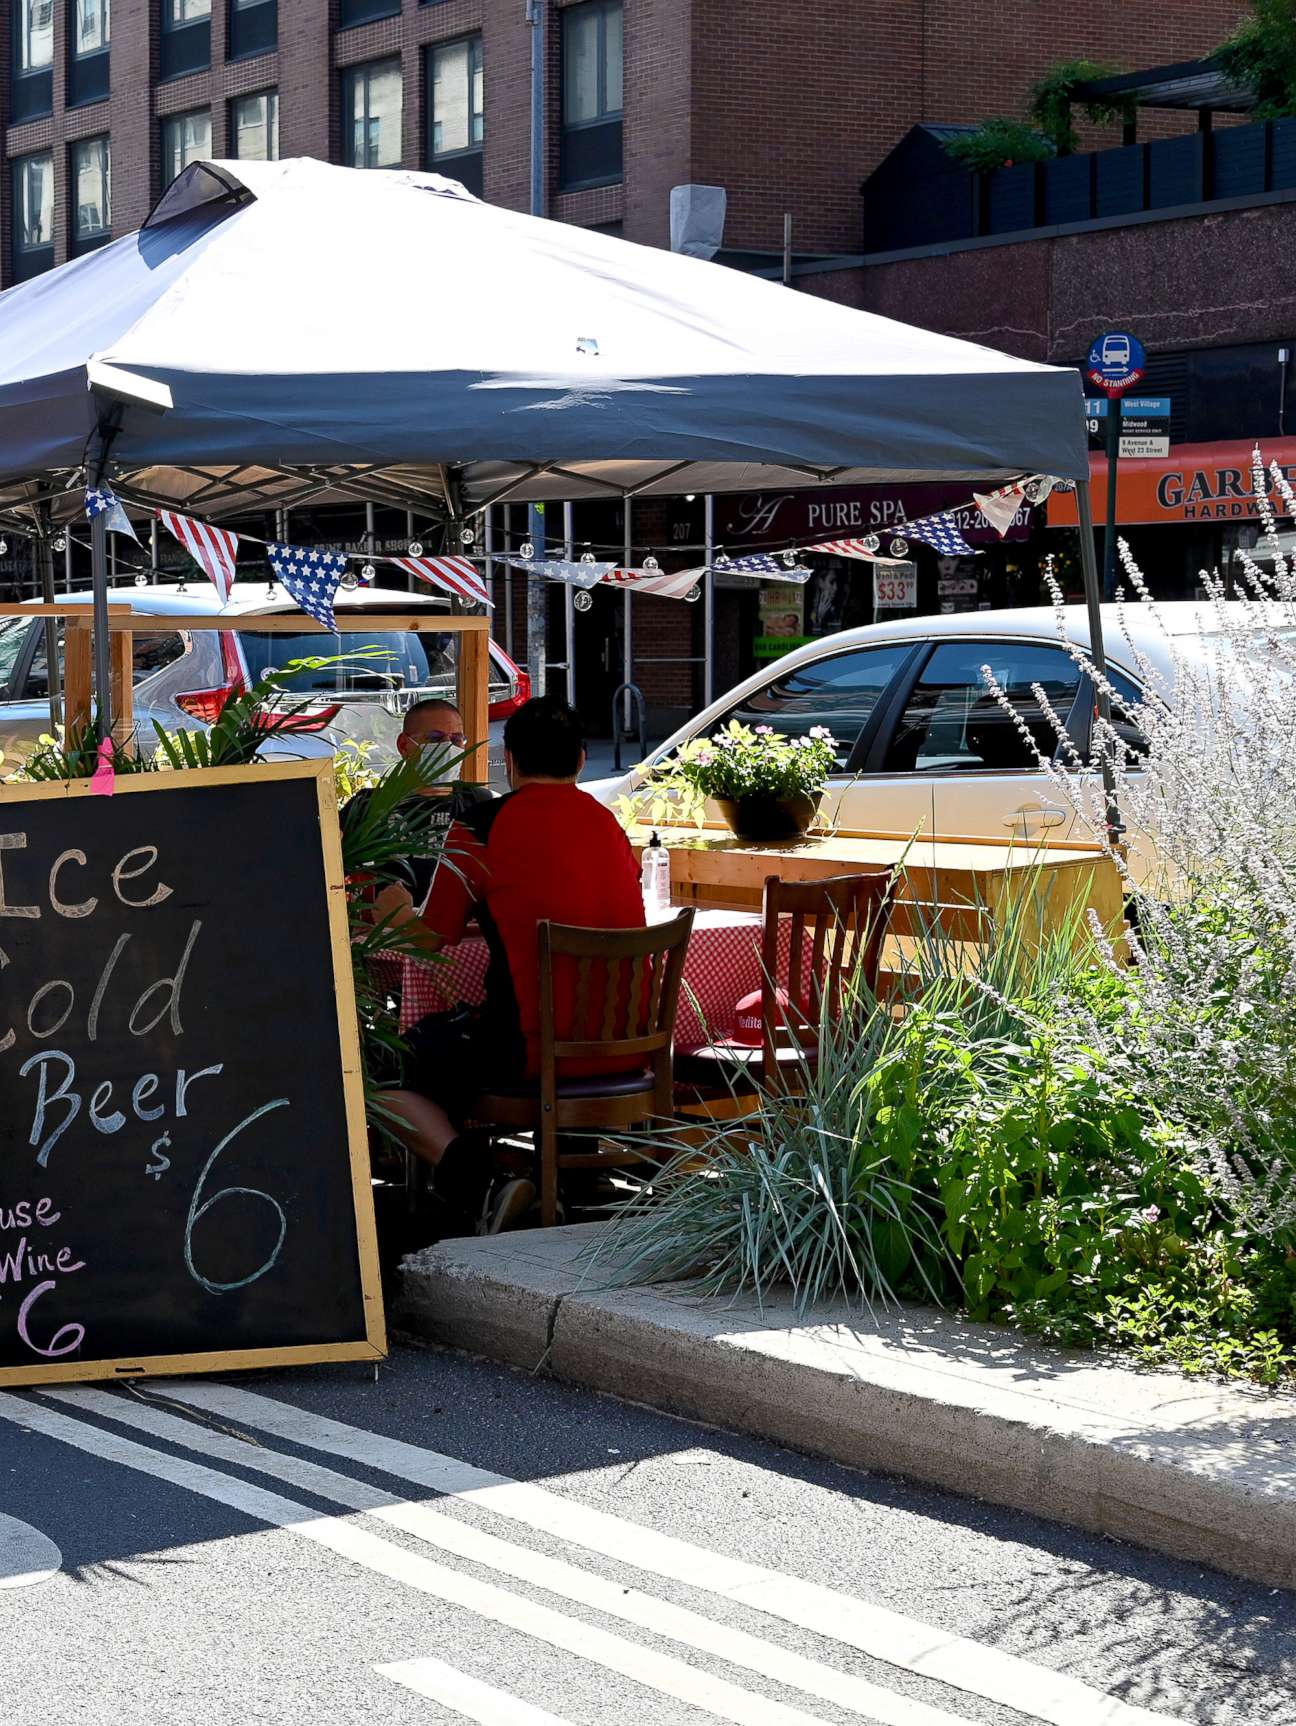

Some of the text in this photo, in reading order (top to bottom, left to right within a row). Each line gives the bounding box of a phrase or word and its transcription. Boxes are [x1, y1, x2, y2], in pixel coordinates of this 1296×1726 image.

[1091, 371, 1140, 387] NO STANDING
[808, 501, 862, 528] PURE
[870, 499, 908, 525] SPA
[672, 522, 692, 541] 207
[19, 1049, 224, 1168] Beer
